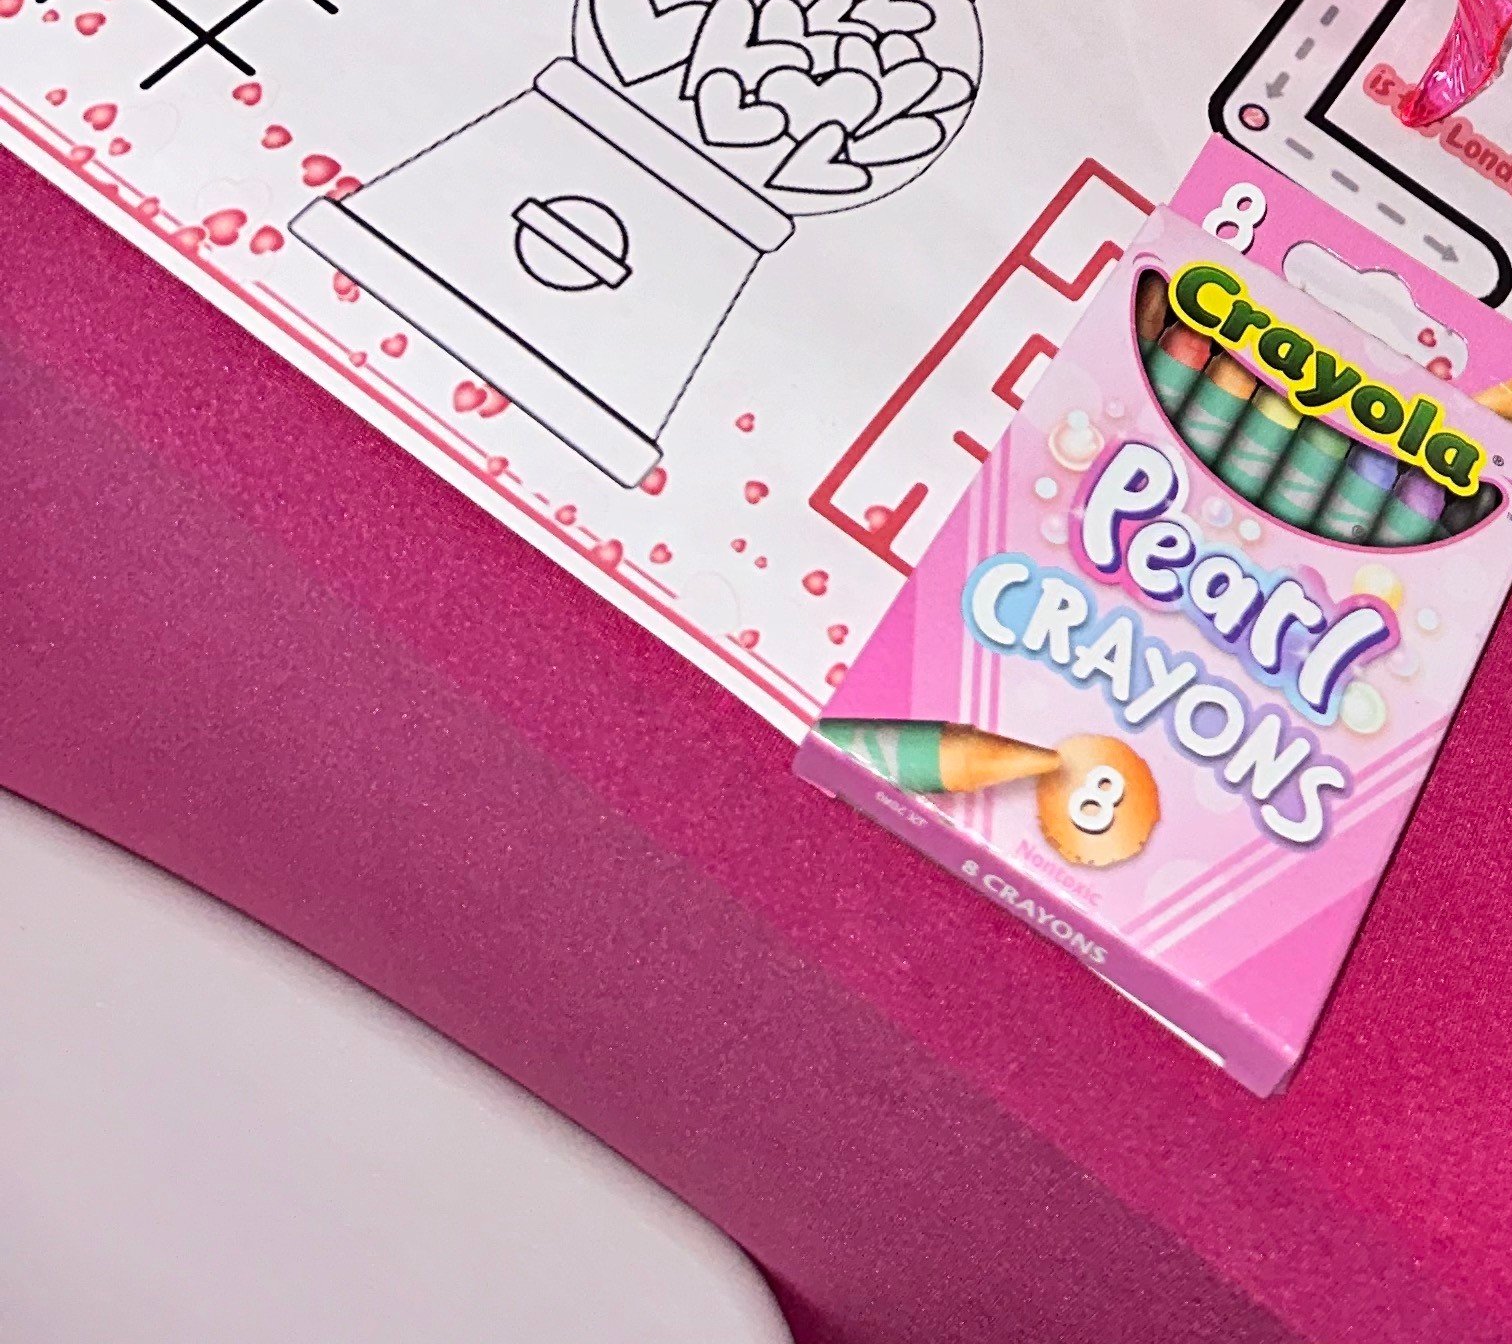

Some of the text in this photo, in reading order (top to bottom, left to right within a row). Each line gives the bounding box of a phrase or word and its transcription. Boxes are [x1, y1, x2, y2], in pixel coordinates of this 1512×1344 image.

[1367, 69, 1396, 96] is
[1202, 181, 1267, 255] 8
[1172, 264, 1482, 490] Crayola
[1080, 441, 1392, 712] Pearl
[972, 562, 1347, 846] CRAYONS
[1068, 764, 1126, 835] 8
[960, 859, 1109, 964] 8 CRAYONS
